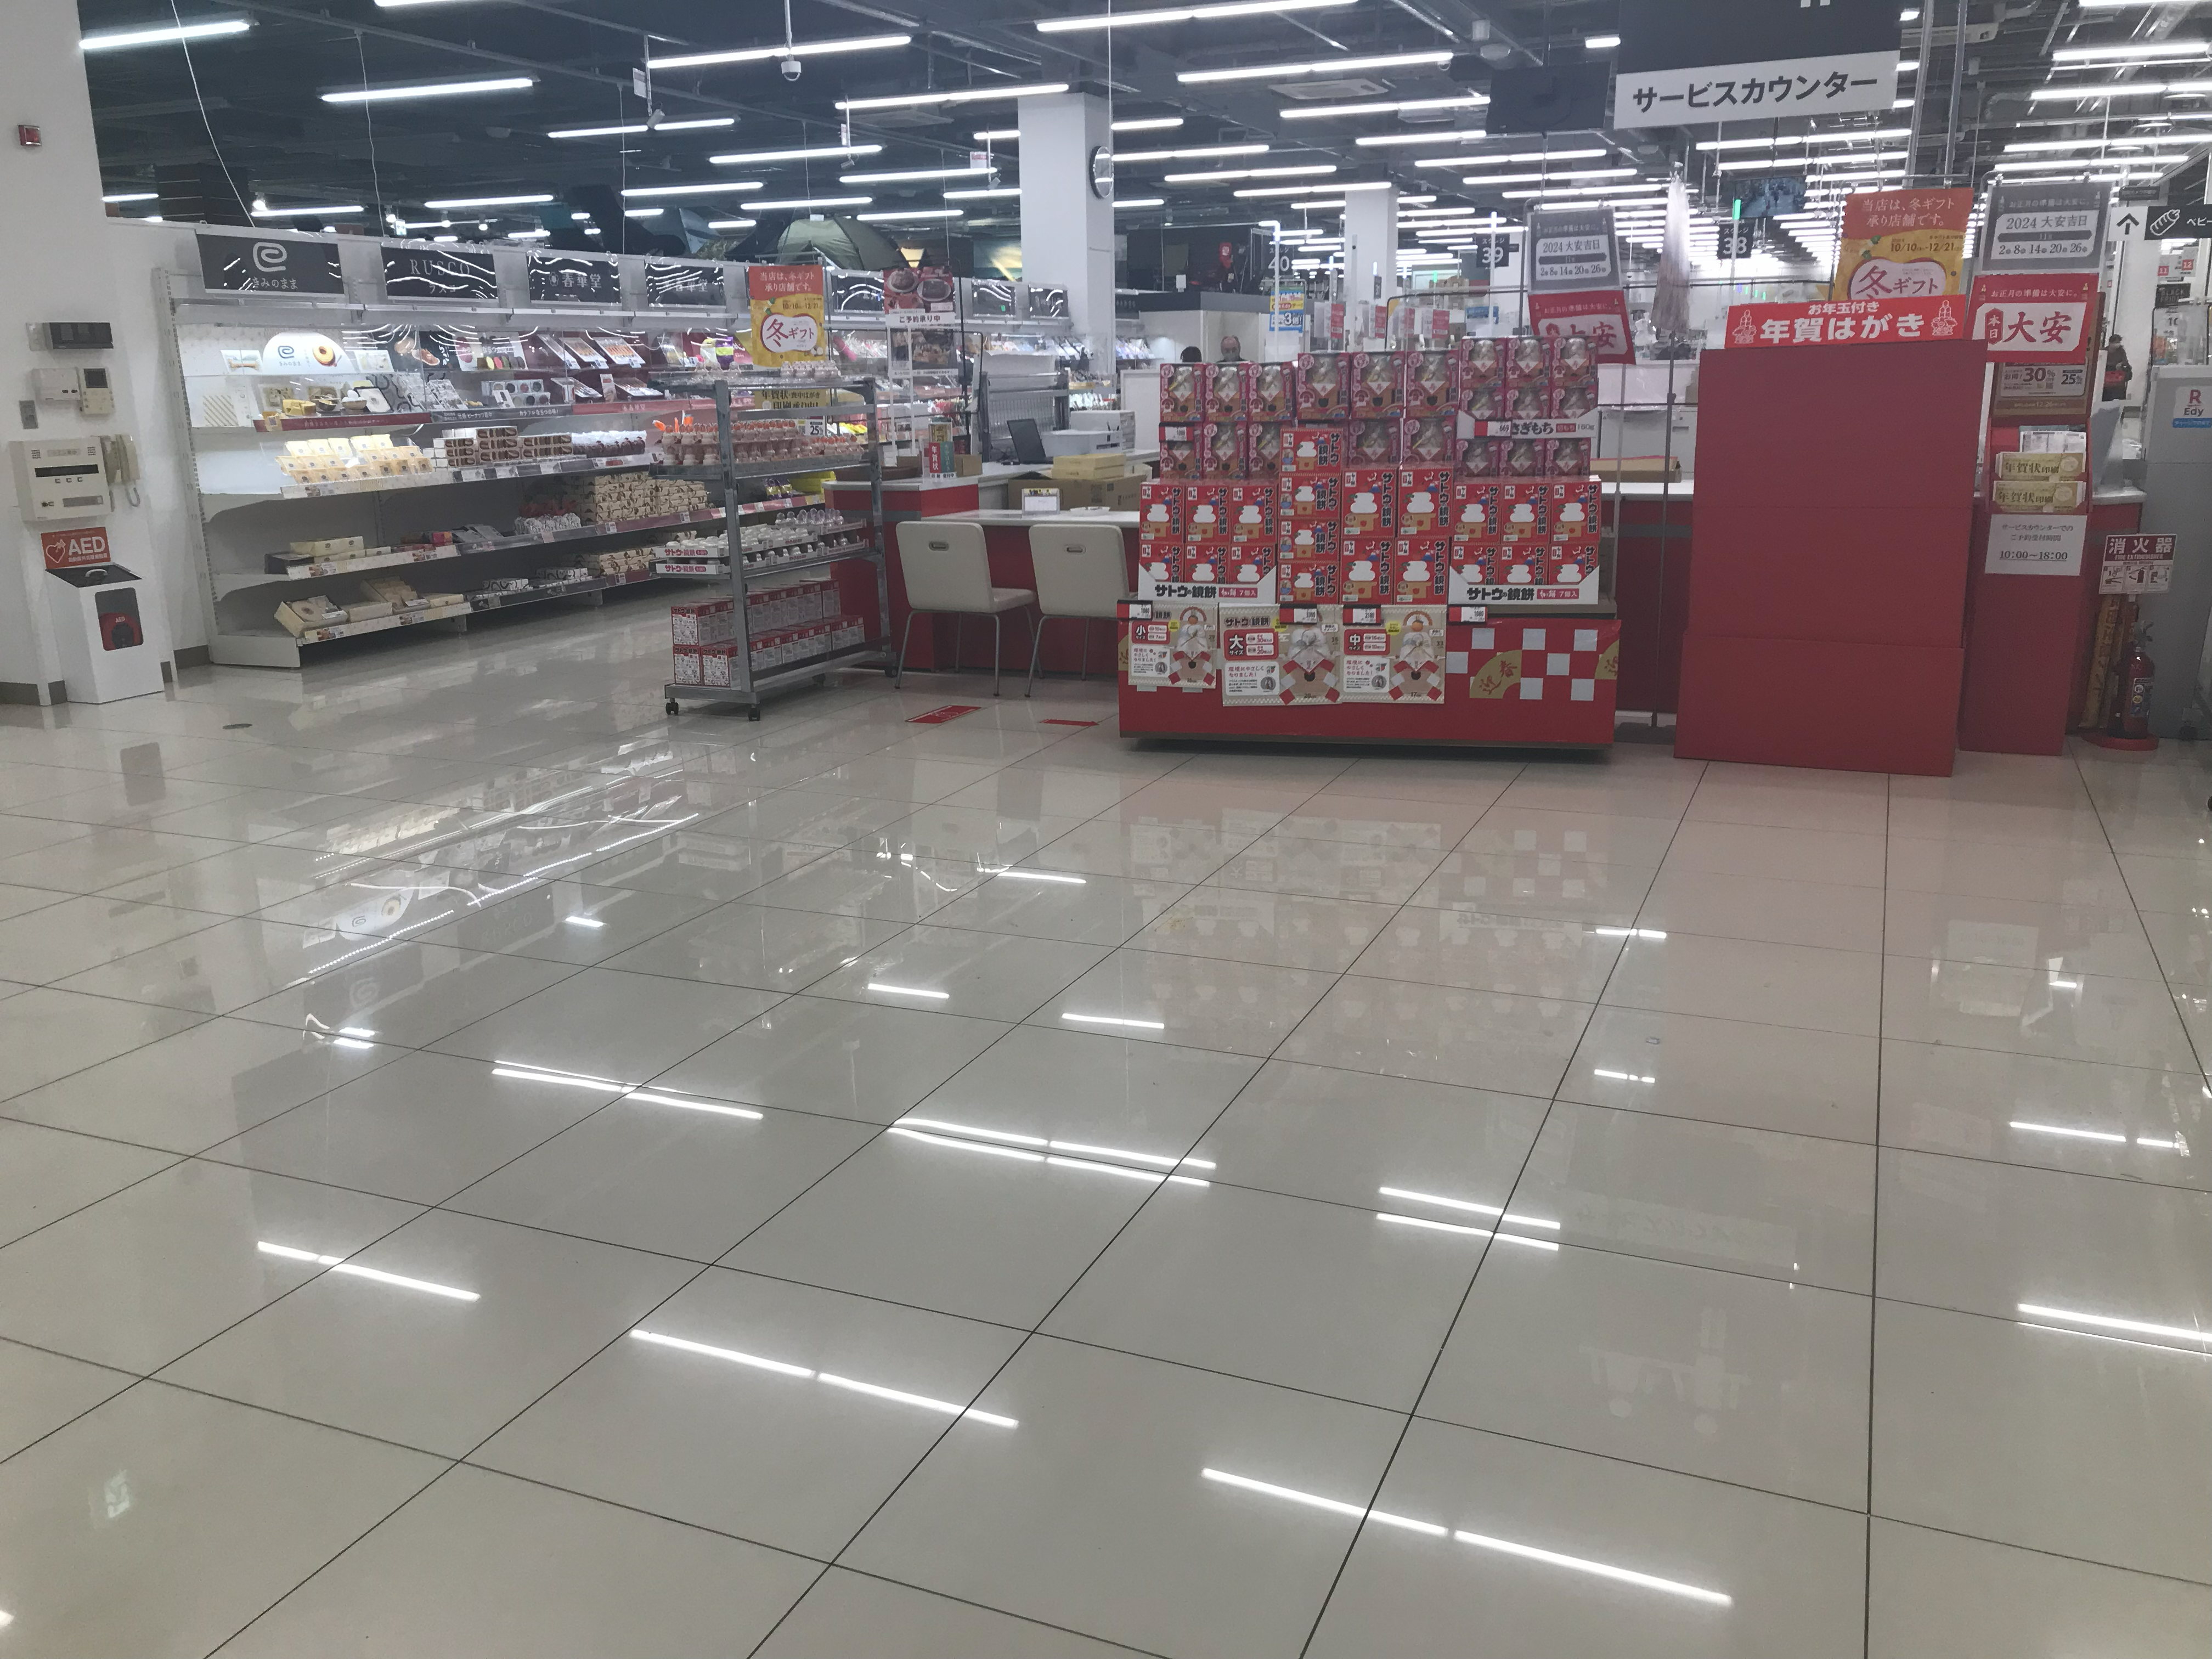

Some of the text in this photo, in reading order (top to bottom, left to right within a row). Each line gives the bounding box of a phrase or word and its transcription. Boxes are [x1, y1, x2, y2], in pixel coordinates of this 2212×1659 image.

[1633, 72, 1877, 113] サービスカウンター
[1863, 197, 1955, 212] 当店は、冬ギフト
[1866, 213, 1944, 227] 承り店舗です。
[2006, 215, 2087, 230] 2024 大安吉日
[1543, 239, 1600, 253] 2024 大安吉日
[1723, 236, 1747, 255] 38
[1482, 247, 1503, 263] 39
[409, 259, 470, 275] RUSCO
[1268, 256, 1290, 272] 40
[252, 277, 298, 290] きみのまま
[562, 273, 602, 289] 春華堂
[1855, 265, 1938, 300] 冬ギフト
[1991, 288, 2078, 298] お正月の準備は大安に。
[1808, 302, 1880, 314] お年玉付き
[766, 318, 815, 347] 冬ギフト
[1760, 313, 1925, 344] 年賀はがき
[1989, 314, 2001, 339] 本日
[2002, 311, 2072, 344] 大安
[2189, 389, 2202, 404] R
[2184, 407, 2204, 417] Edy
[2002, 523, 2074, 532] サービスカウンターでの
[69, 536, 105, 556] AED
[2109, 537, 2172, 554] 消火器
[1155, 585, 1217, 599] サトウの鏡餅
[1466, 588, 1535, 601] サトウの鏡餅
[1136, 625, 1146, 635] 小
[1229, 634, 1244, 650] 大
[1350, 634, 1361, 646] 中
